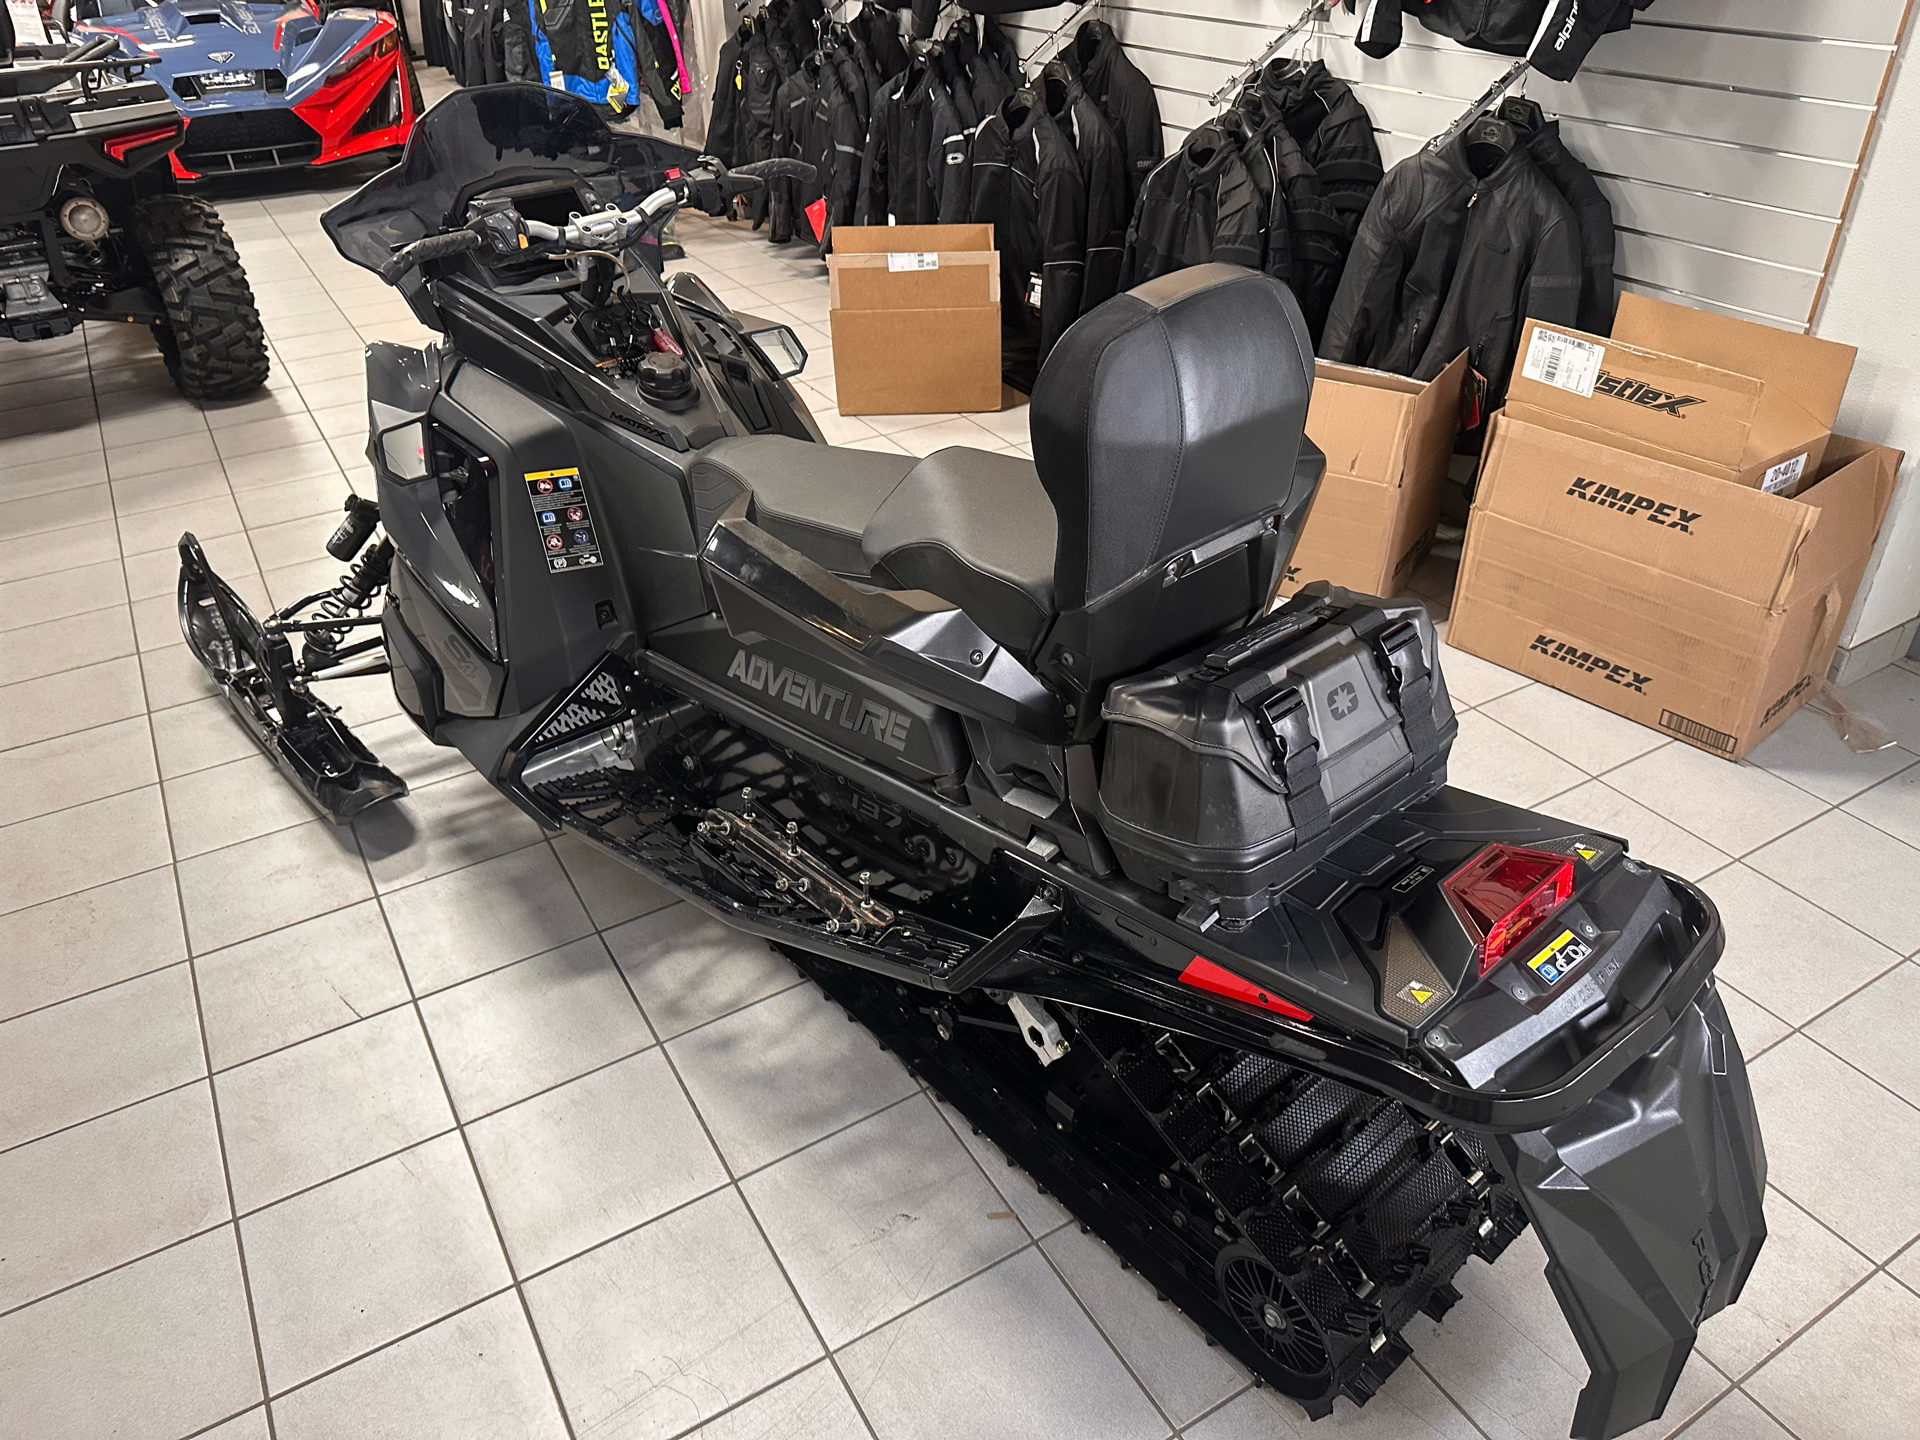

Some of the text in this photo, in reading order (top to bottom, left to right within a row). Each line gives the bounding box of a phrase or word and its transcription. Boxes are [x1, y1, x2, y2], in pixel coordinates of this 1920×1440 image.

[610, 411, 668, 441] MATRYX
[1566, 477, 1702, 534] KIMPEX
[1529, 634, 1653, 694] KIMPEX
[727, 649, 912, 752] ADVENTURE
[851, 793, 903, 829] 137
